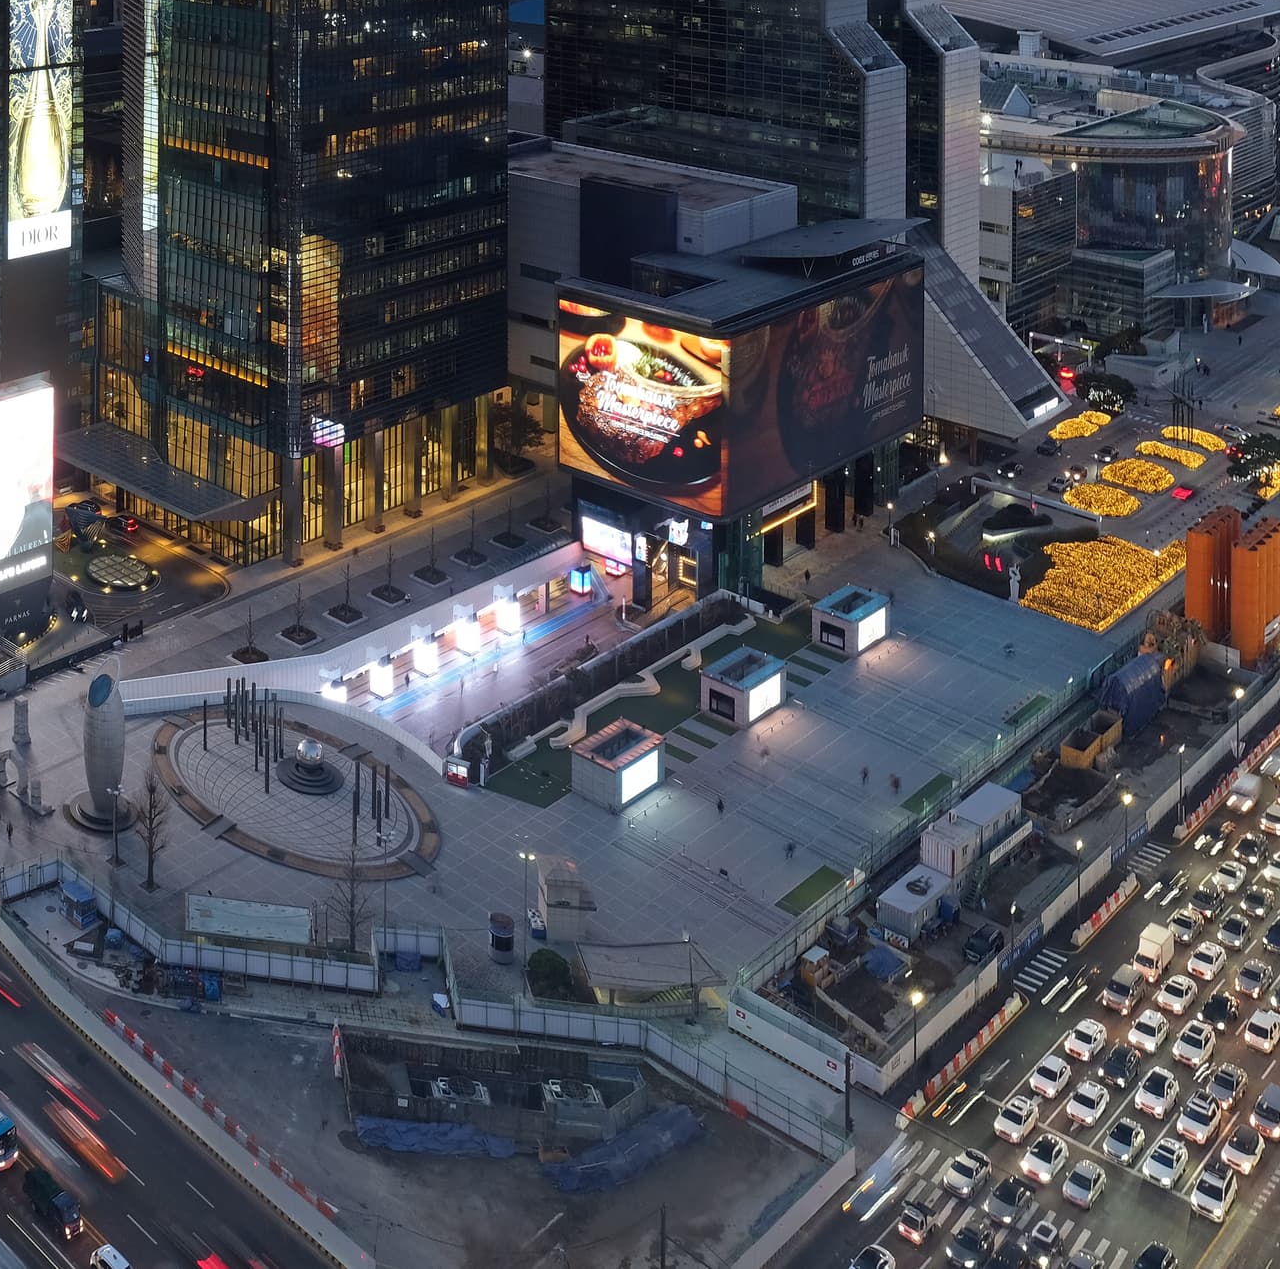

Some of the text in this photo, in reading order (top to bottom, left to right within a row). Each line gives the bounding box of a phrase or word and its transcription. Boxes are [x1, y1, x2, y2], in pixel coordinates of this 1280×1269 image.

[21, 225, 58, 247] DIOR
[867, 343, 911, 380] Tomahawk
[863, 372, 912, 409] Masterpiece
[597, 390, 681, 431] Masterpiece
[4, 610, 31, 625] PARNAS
